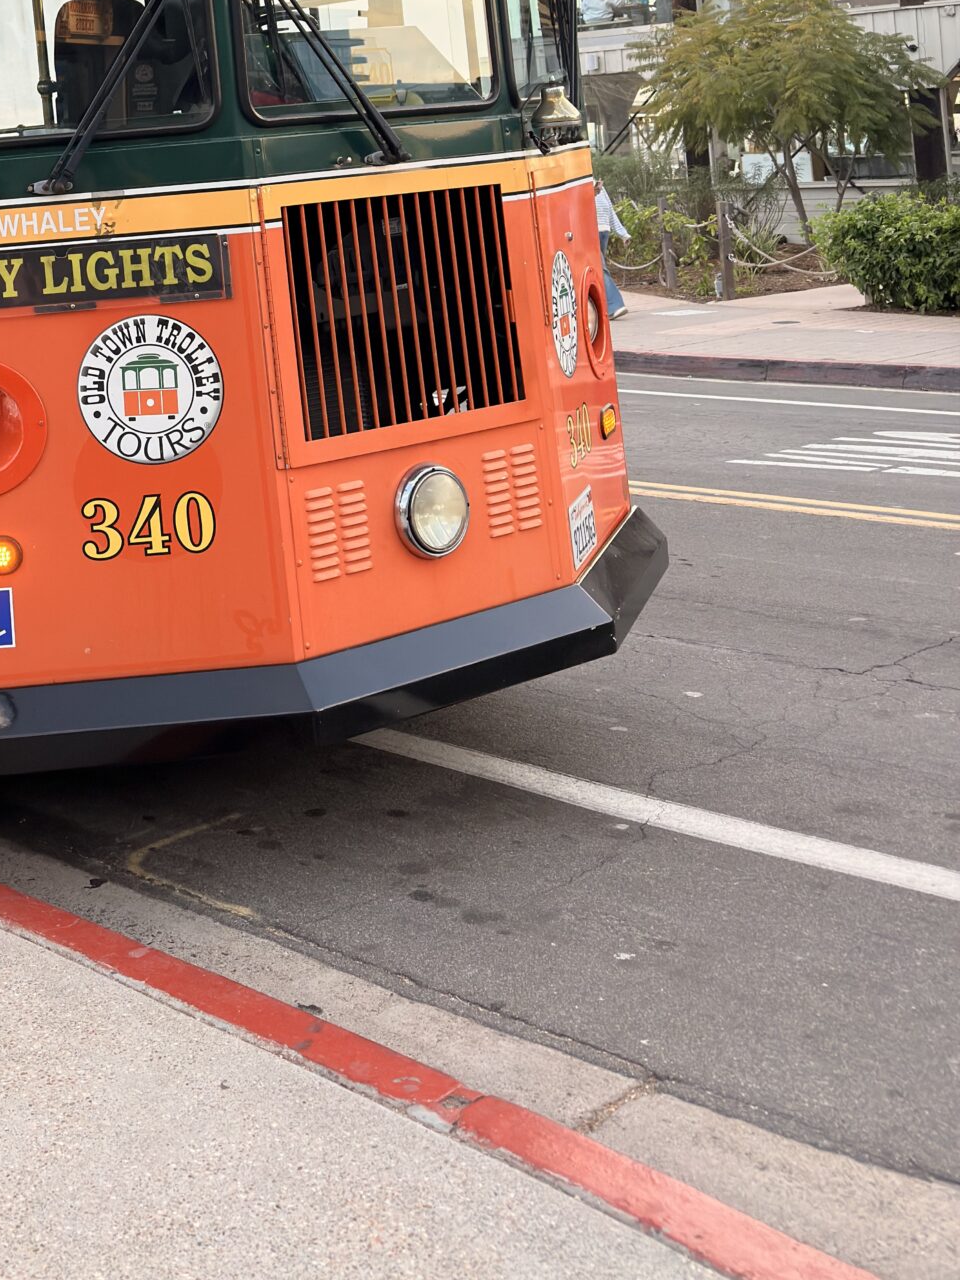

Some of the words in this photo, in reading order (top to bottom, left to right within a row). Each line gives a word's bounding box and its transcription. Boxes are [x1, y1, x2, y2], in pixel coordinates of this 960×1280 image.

[40, 242, 214, 295] LIGHTS
[90, 317, 147, 364] TOWN
[155, 317, 221, 402] TROLLEY
[80, 365, 106, 406] OLD
[101, 416, 207, 462] TOURS
[567, 401, 591, 469] 340
[82, 490, 217, 563] 340
